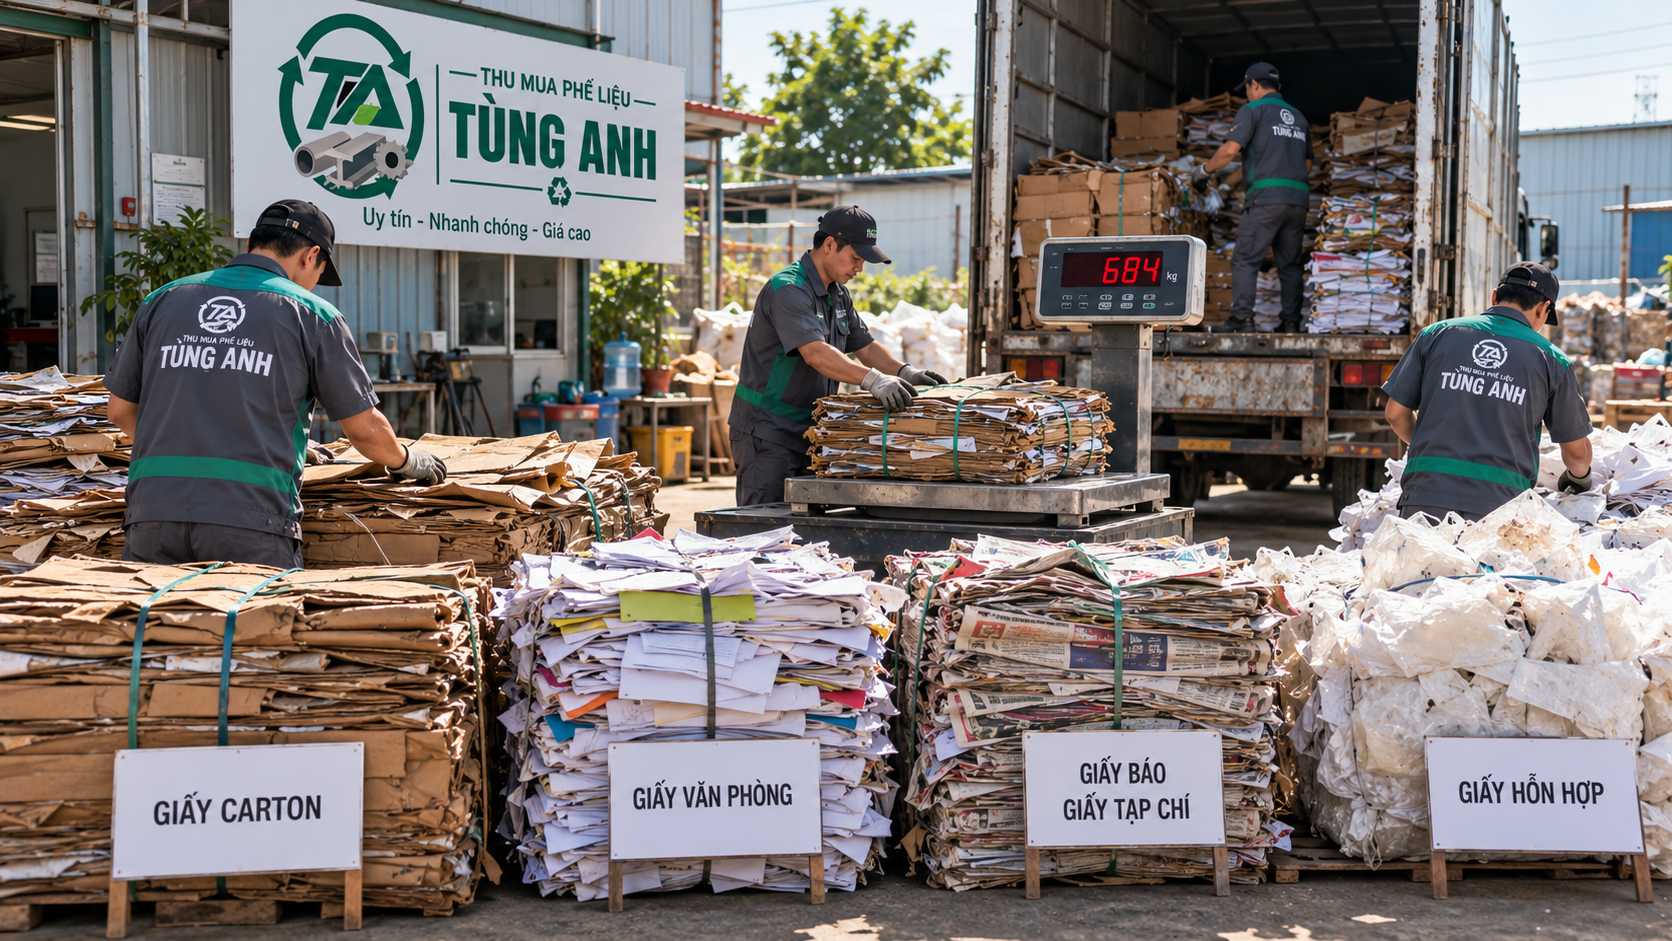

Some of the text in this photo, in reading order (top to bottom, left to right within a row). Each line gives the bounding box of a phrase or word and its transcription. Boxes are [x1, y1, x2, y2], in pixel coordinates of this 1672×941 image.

[480, 66, 631, 111] THU MUA PHẾ LIỆU
[448, 92, 657, 181] TÙNG ANH
[363, 206, 386, 231] Uy
[389, 208, 412, 229] tín
[429, 212, 479, 234] Nhanh
[483, 216, 528, 242] chóng
[542, 221, 564, 240] Giá
[568, 227, 591, 242] cao
[1102, 256, 1161, 284] 684
[1166, 271, 1178, 283] kg
[183, 335, 199, 343] THU
[160, 338, 274, 377] TÙNG ANH
[1441, 368, 1527, 406] TÙNG ANH
[1080, 755, 1166, 785] GIẤY BÁO
[153, 791, 322, 826] GIẤY CARTON
[632, 778, 793, 811] GIẤY VĂN PHÒNG
[1063, 791, 1190, 825] GIẤY TẠP CHÍ
[1458, 772, 1605, 810] GIẤY HỖN HỢP
